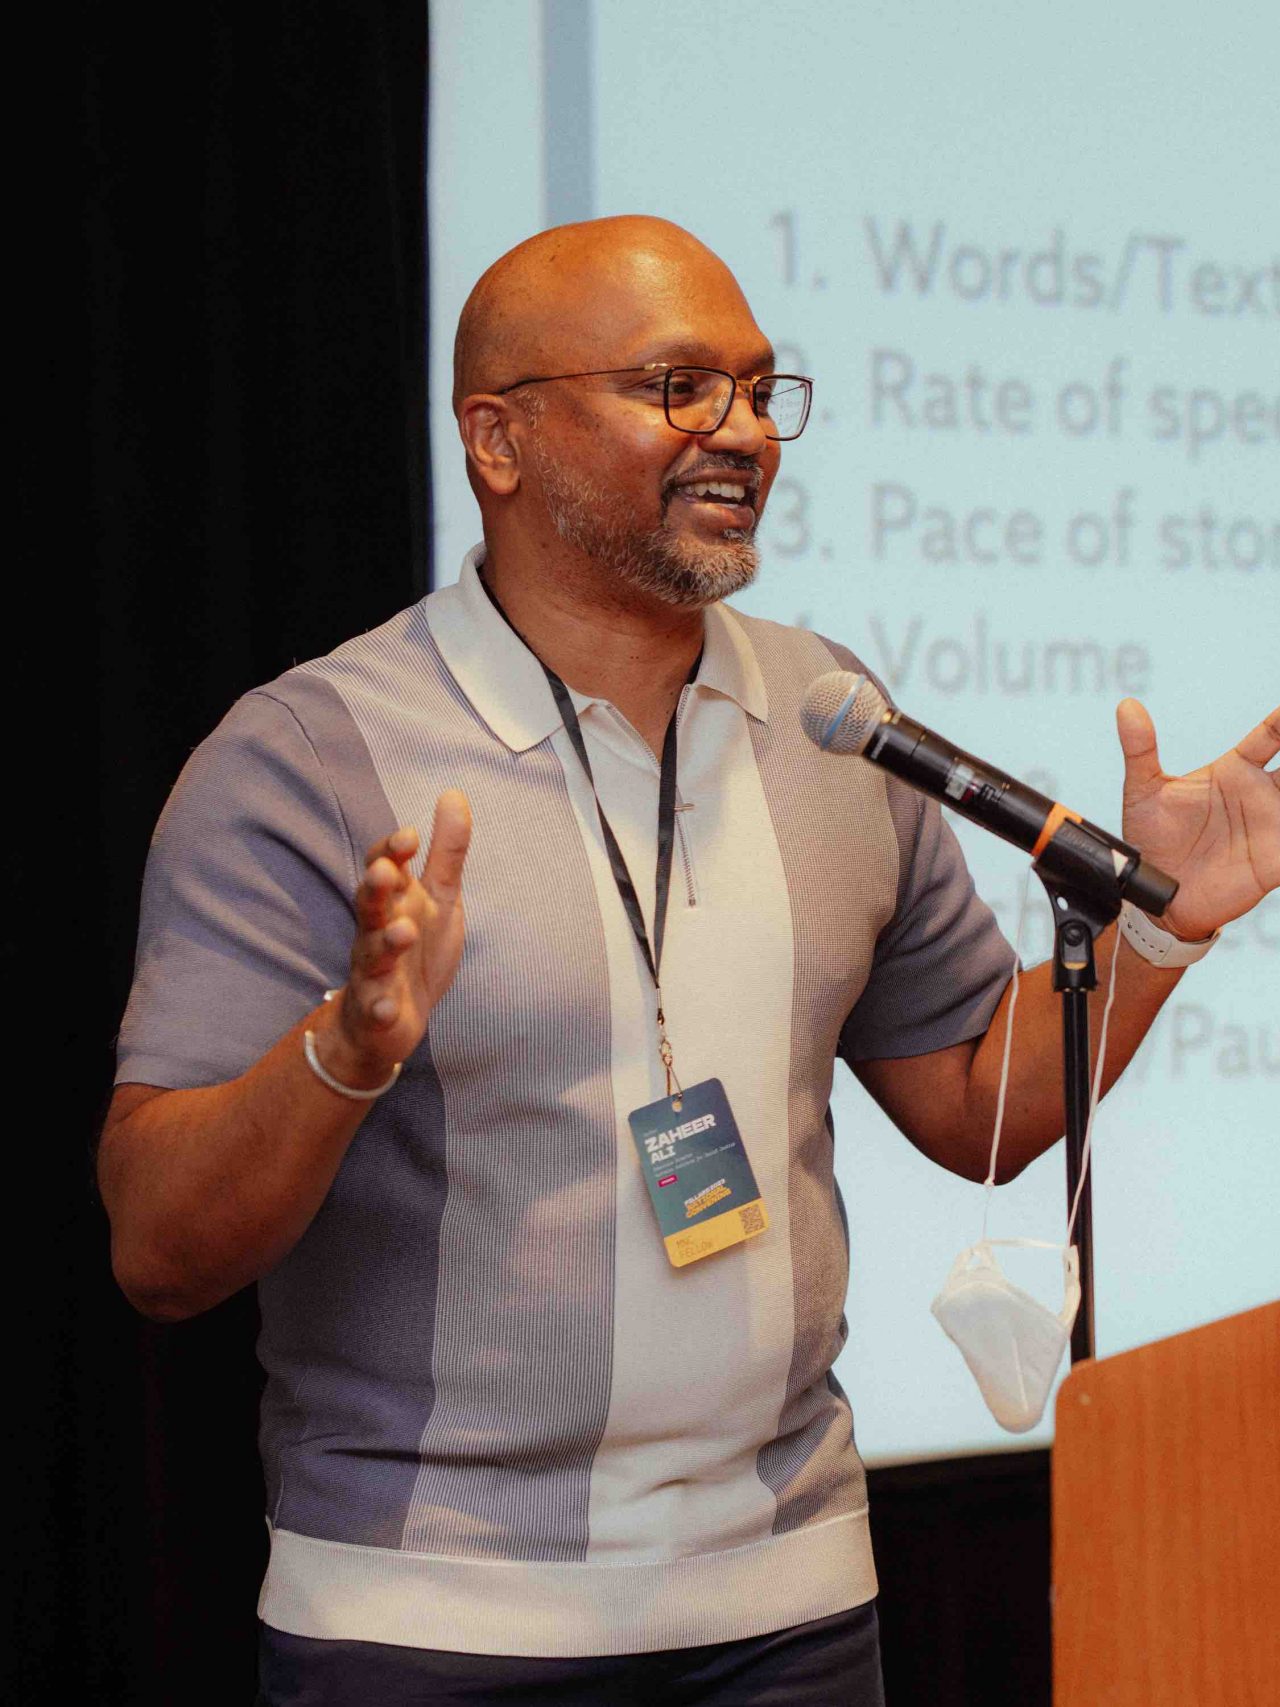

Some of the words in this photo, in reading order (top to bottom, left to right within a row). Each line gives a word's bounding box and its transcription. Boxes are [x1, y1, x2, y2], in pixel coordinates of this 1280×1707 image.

[769, 209, 828, 292] 1.
[869, 346, 1035, 434] Rate
[1055, 355, 1130, 438] of
[772, 477, 837, 560] 3.
[869, 481, 1046, 568] Pace
[1064, 484, 1138, 569] of
[868, 609, 1154, 698] Volume
[644, 1113, 717, 1154] ZAHEER
[650, 1146, 677, 1165] ALI
